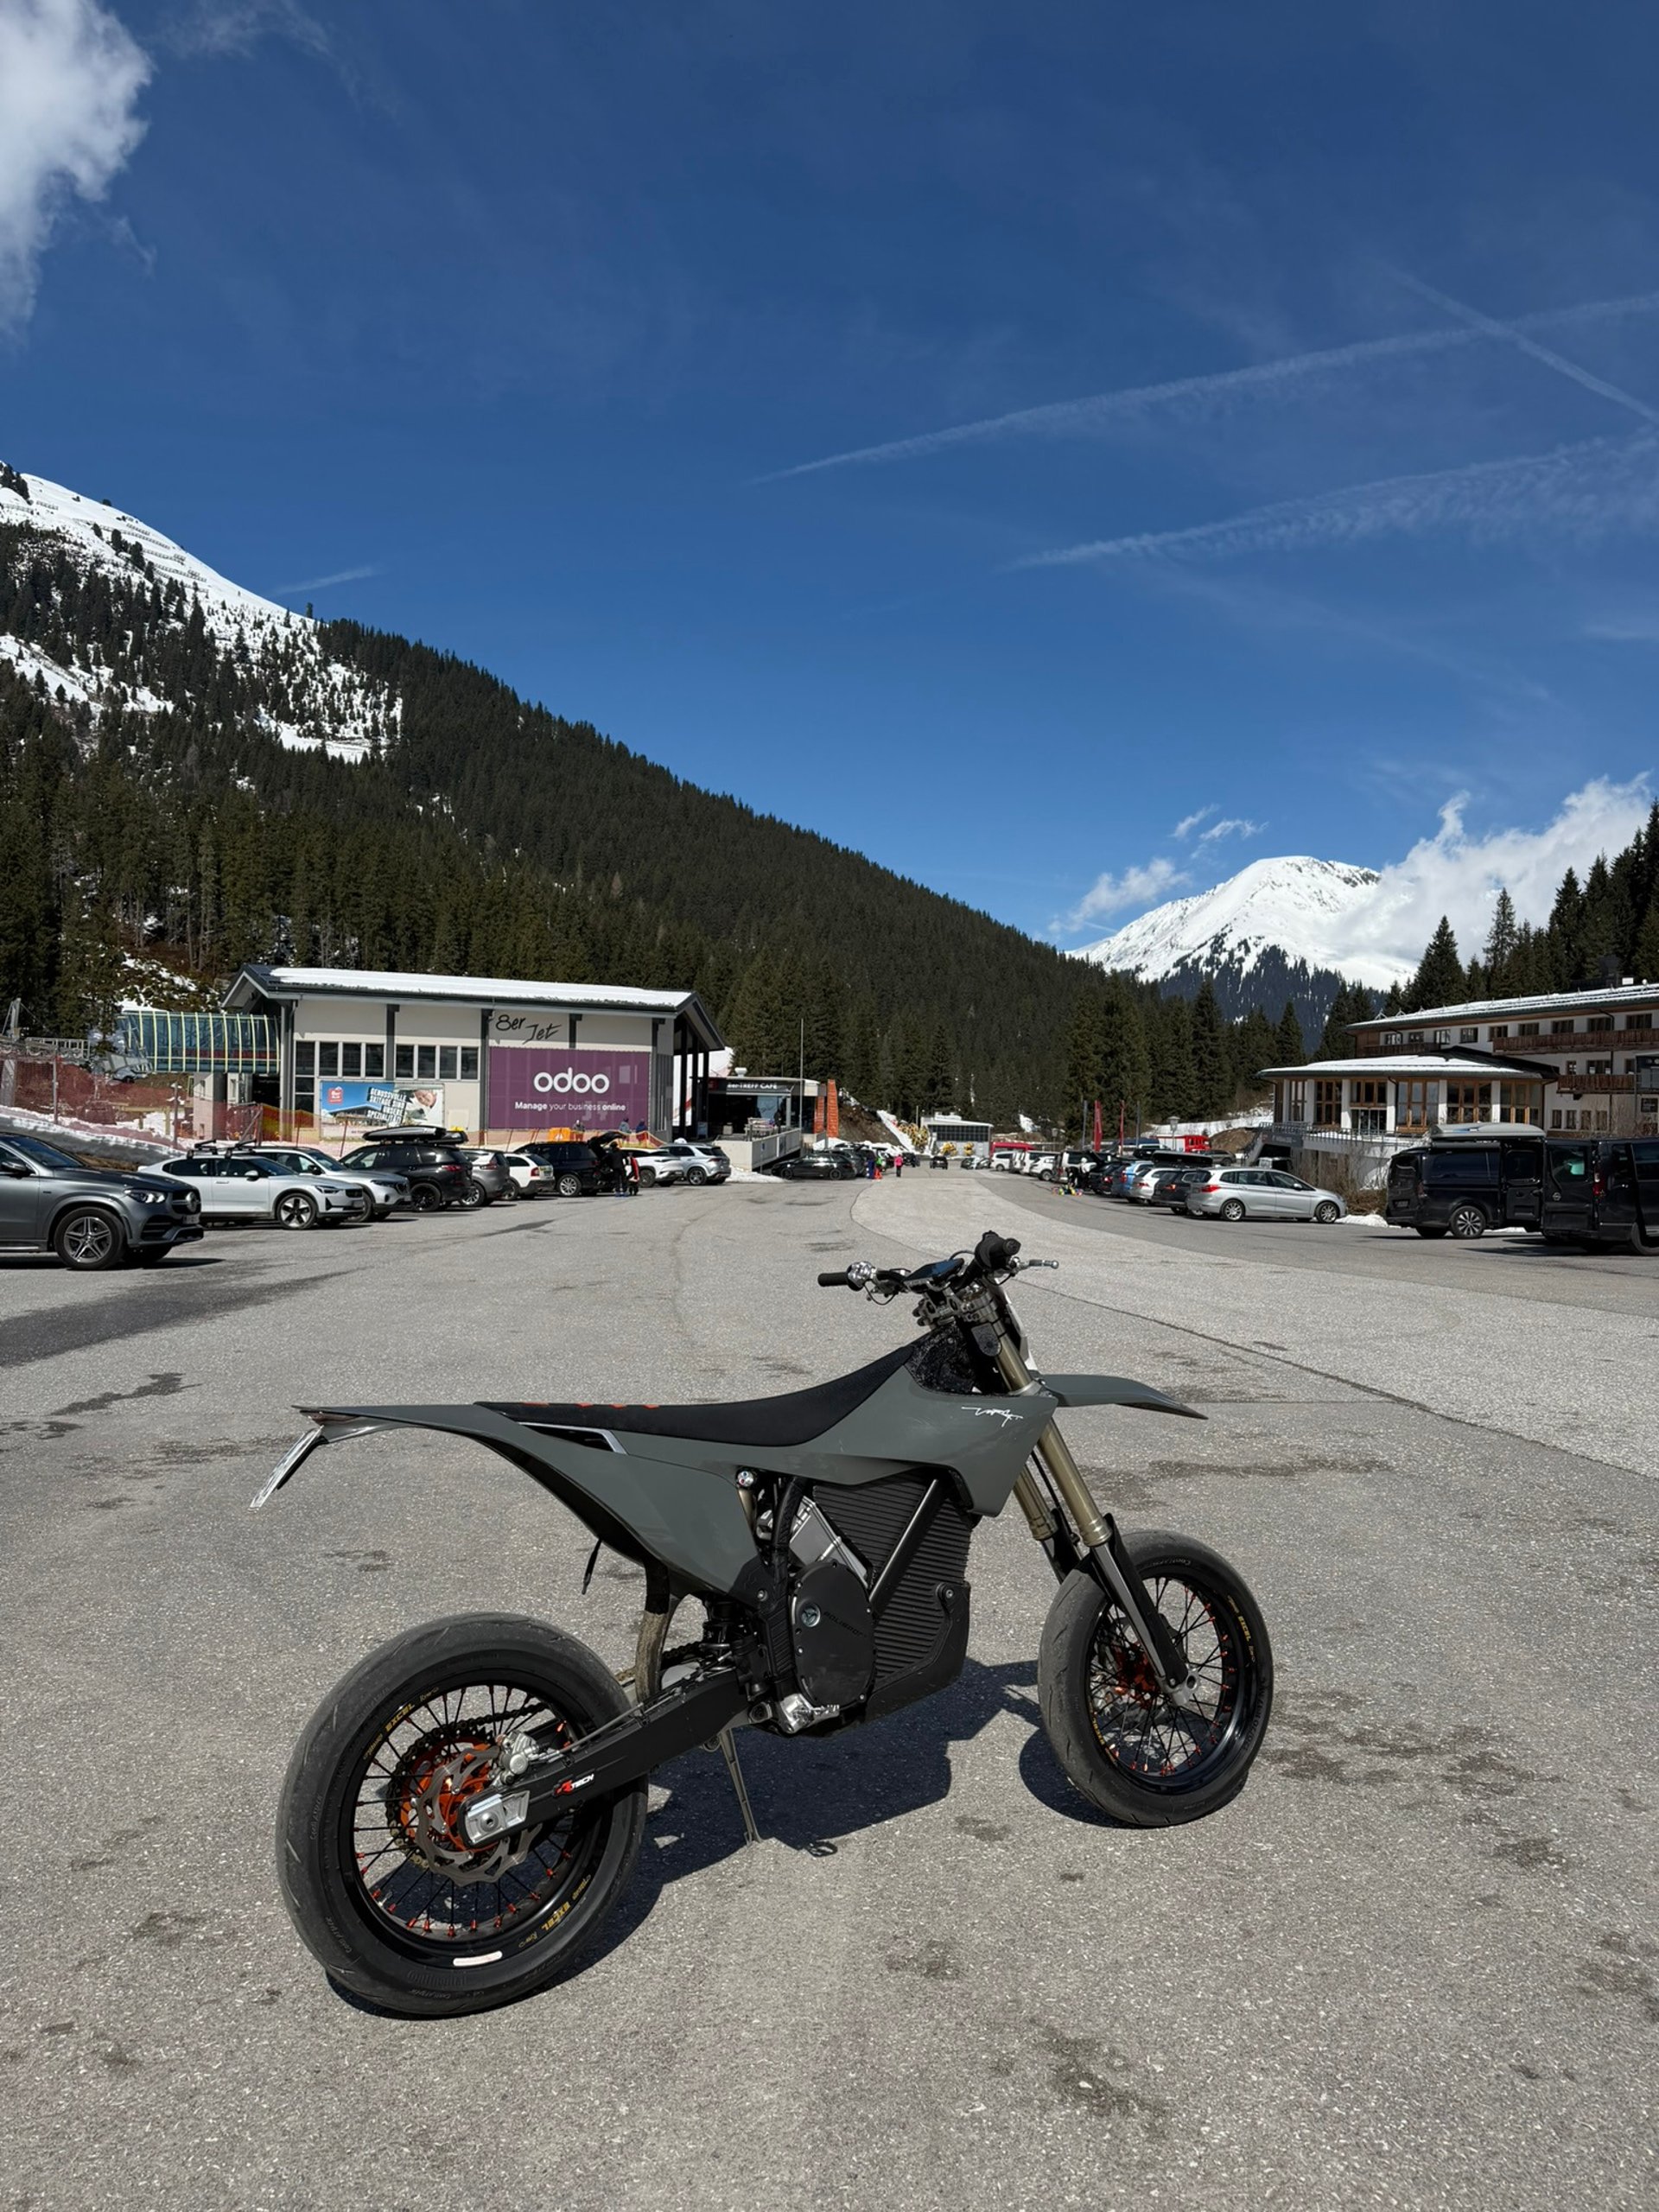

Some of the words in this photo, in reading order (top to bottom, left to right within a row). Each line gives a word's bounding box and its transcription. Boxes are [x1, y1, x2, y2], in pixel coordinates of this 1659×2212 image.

[495, 1014, 526, 1031] 8er
[522, 1023, 562, 1045] Jet
[533, 1066, 610, 1094] odoo
[515, 1101, 548, 1112] Manage
[549, 1103, 566, 1112] your
[568, 1101, 601, 1111] business
[601, 1103, 626, 1112] online
[385, 1702, 416, 1732] EXCEL
[541, 1901, 571, 1931] EXCEL
